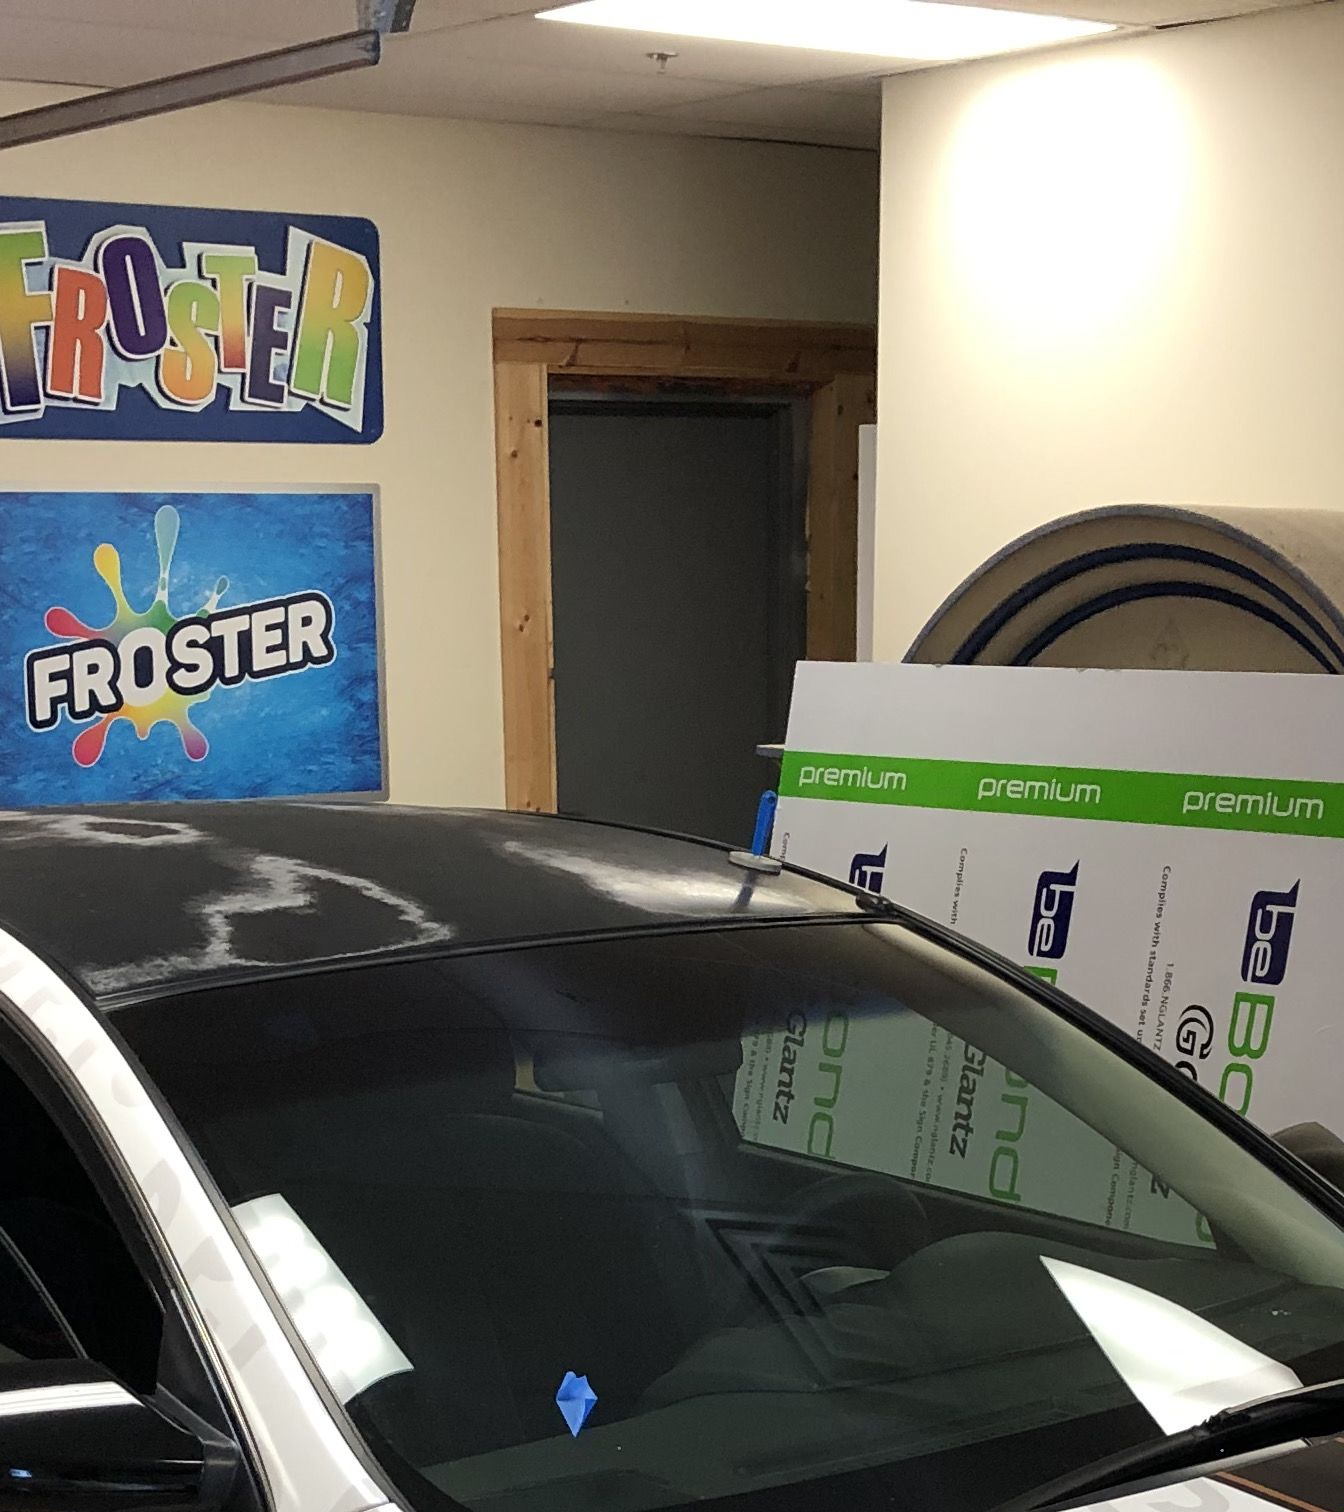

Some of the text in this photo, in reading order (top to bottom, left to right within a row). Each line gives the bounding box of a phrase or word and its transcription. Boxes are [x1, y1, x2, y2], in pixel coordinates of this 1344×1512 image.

[30, 598, 330, 722] FROSTER
[799, 765, 907, 791] premium
[978, 777, 1101, 804] premium
[1183, 789, 1324, 820] premium
[1156, 865, 1171, 919] Complies
[1152, 921, 1161, 947] with
[1142, 951, 1156, 1006] standards
[807, 1013, 849, 1160] ond
